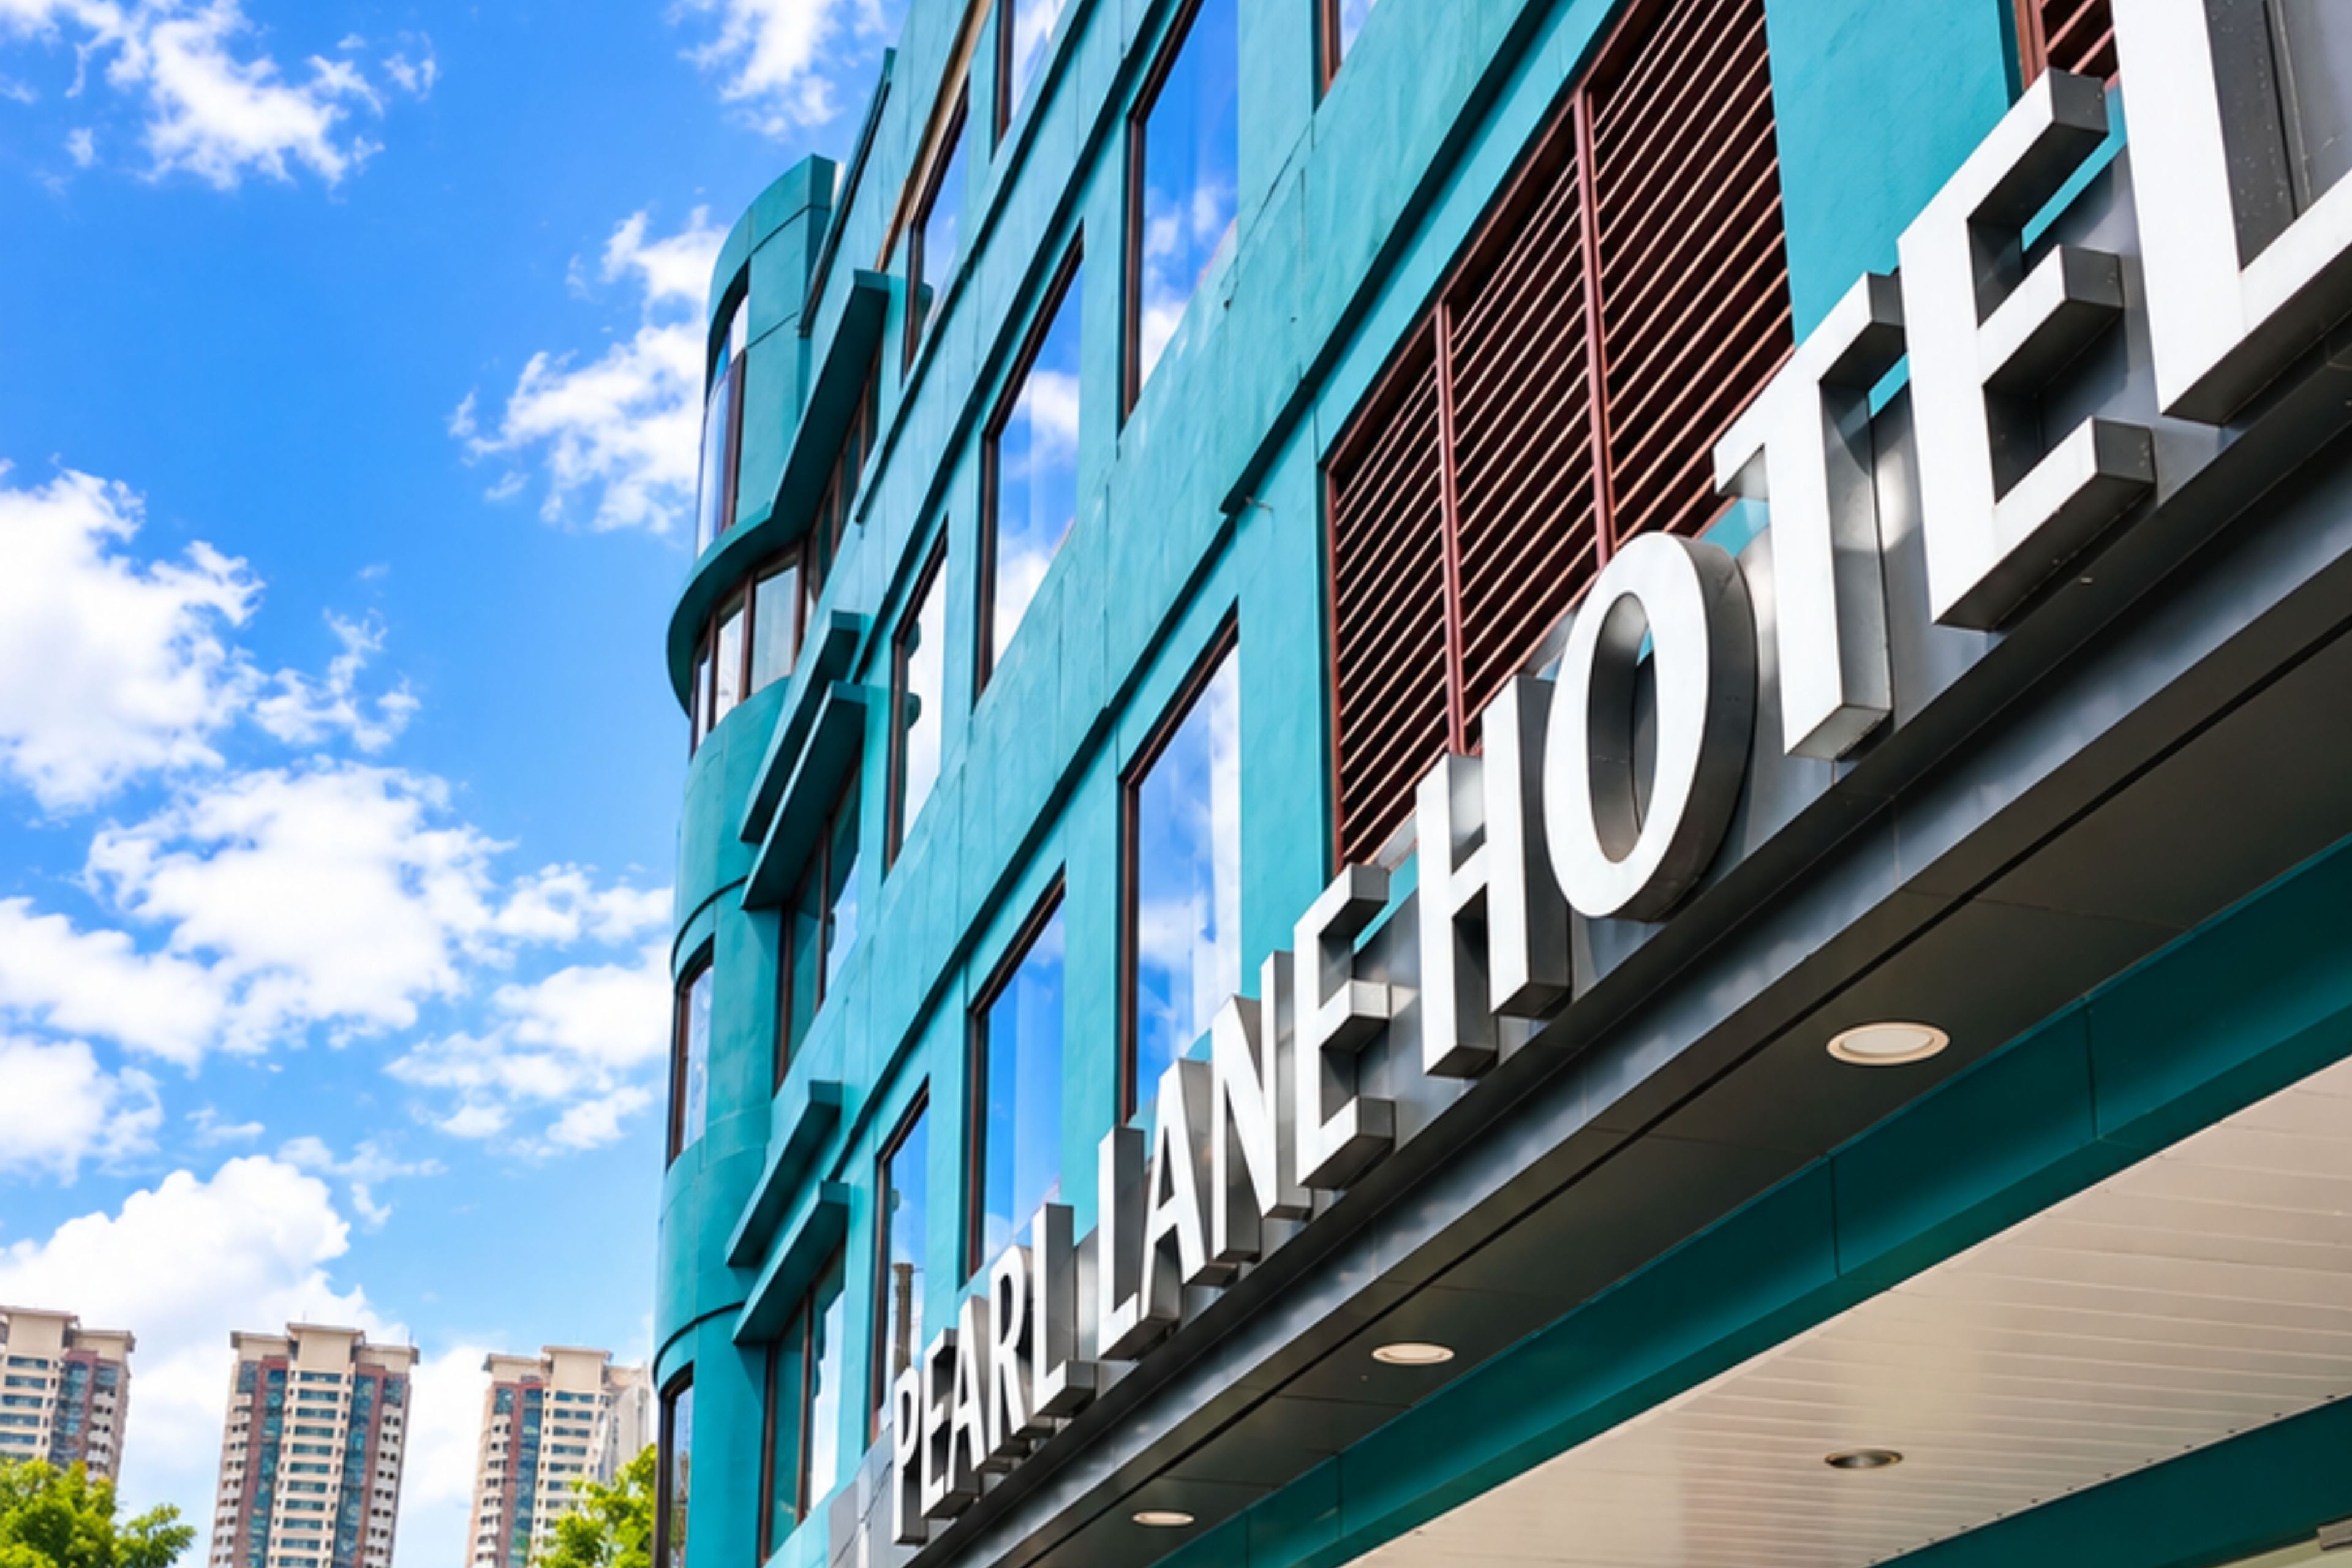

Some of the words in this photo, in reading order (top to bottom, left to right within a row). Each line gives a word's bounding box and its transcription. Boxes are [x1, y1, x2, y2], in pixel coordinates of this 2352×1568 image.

[893, 1203, 1072, 1544] PEARL
[1098, 863, 1363, 1359] LANE
[1416, 0, 2352, 1075] HOTEL
